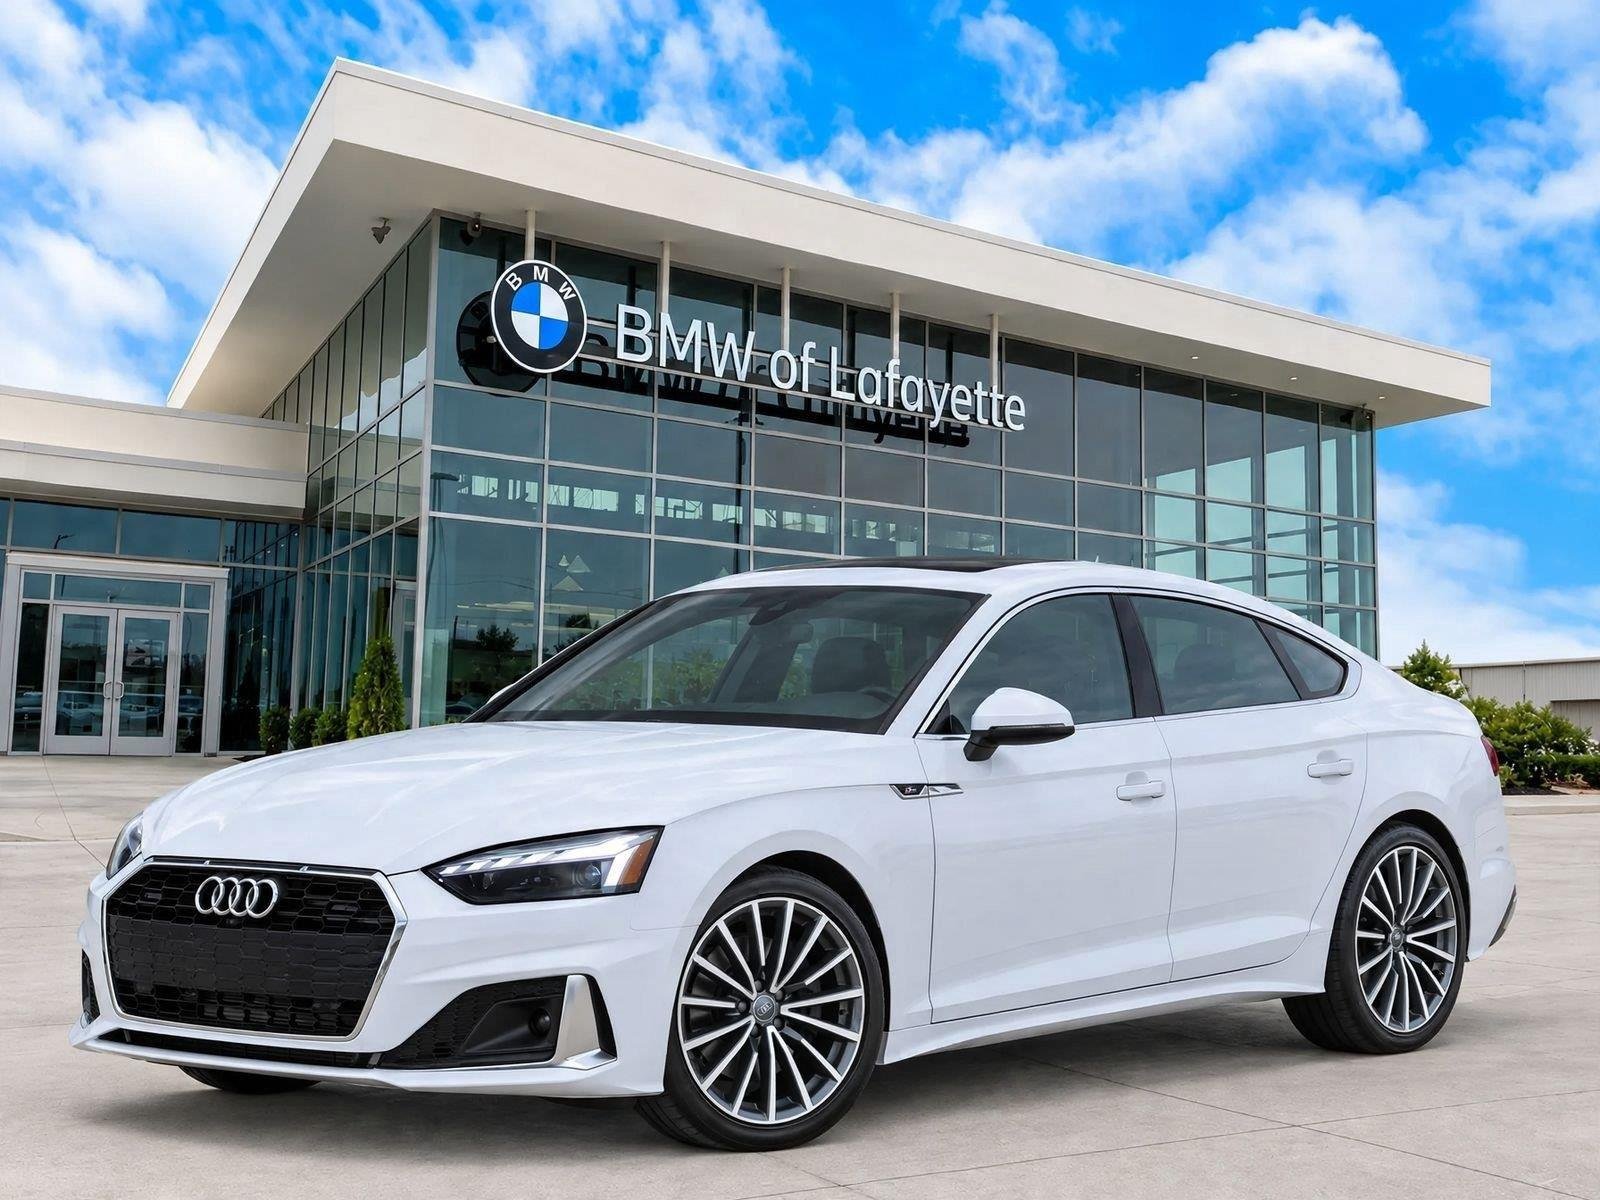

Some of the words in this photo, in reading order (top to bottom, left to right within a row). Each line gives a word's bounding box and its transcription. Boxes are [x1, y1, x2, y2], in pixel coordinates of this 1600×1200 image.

[505, 265, 577, 301] BMW
[616, 304, 756, 382] BMW
[770, 341, 817, 391] of
[830, 346, 1026, 431] Lafayette
